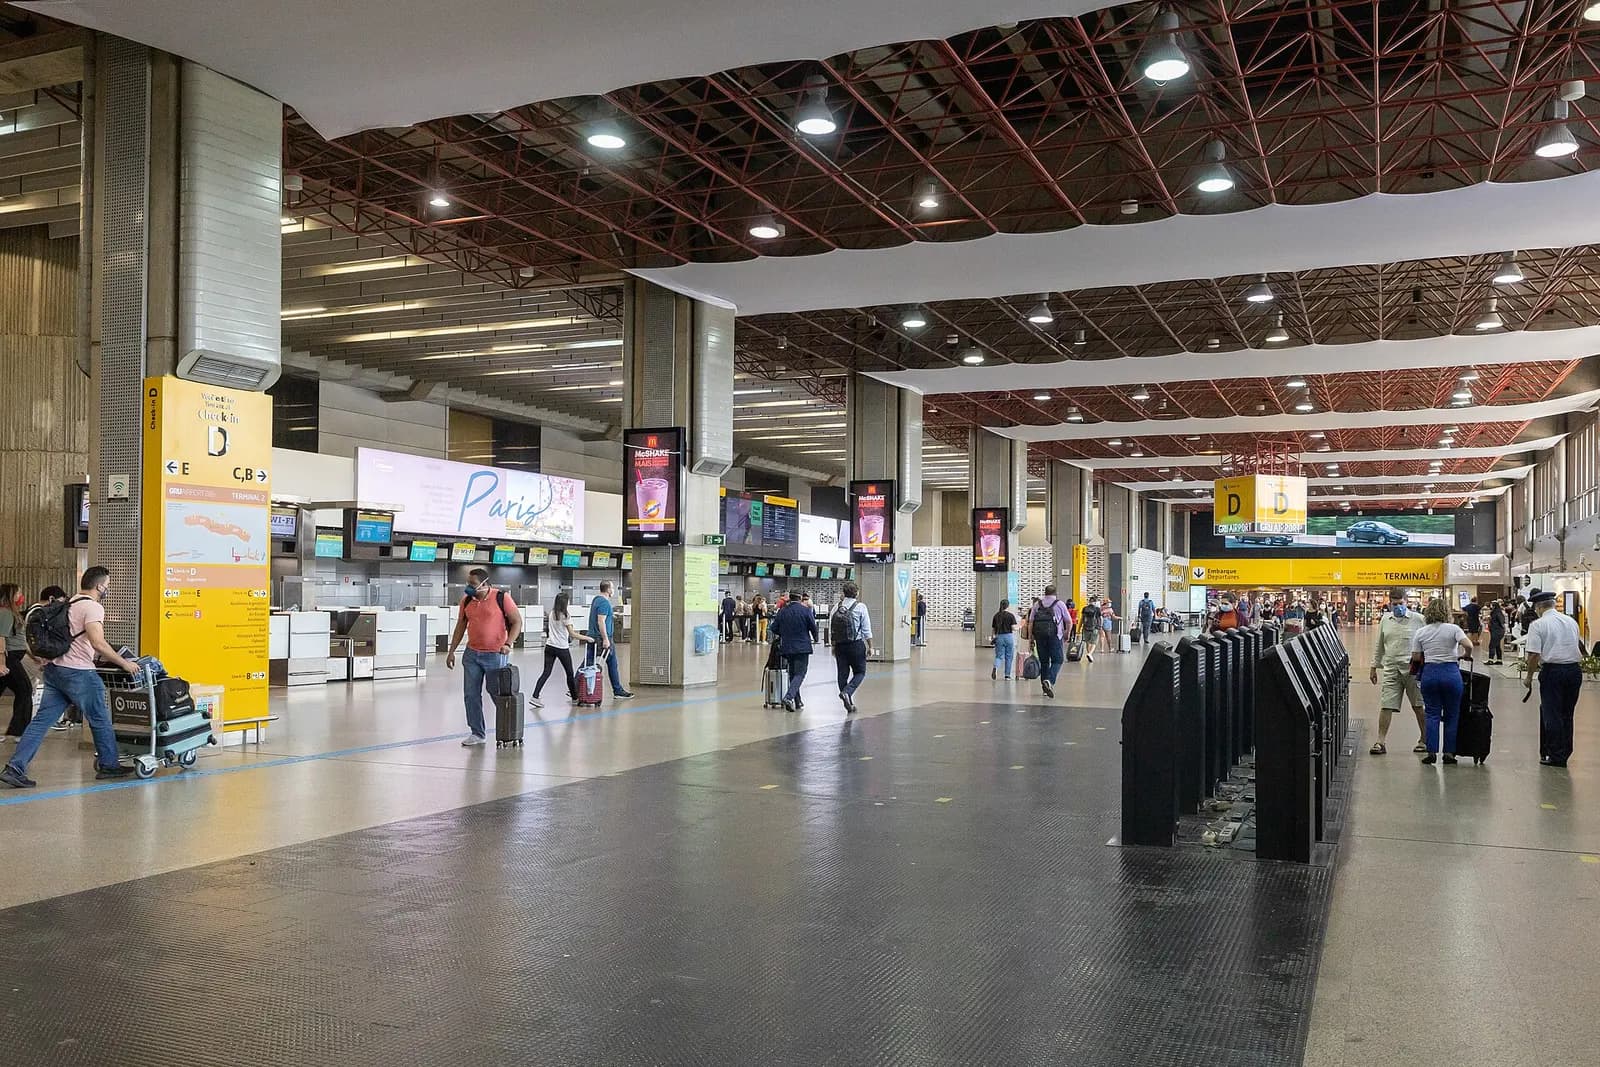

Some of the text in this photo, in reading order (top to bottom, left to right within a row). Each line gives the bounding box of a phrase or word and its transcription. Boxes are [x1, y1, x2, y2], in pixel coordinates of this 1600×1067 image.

[149, 388, 158, 397] D
[198, 409, 239, 424] Check-in
[208, 426, 228, 457] D
[634, 450, 669, 458] McSHAKE
[182, 462, 190, 476] E
[232, 467, 253, 482] C,B
[232, 492, 260, 500] TERMINAL
[458, 470, 553, 532] Paris
[1274, 492, 1289, 514] D
[1228, 493, 1241, 516] D
[1461, 562, 1491, 570] Safra
[1384, 572, 1430, 580] TERMINAL
[126, 700, 147, 710] TOTVS
